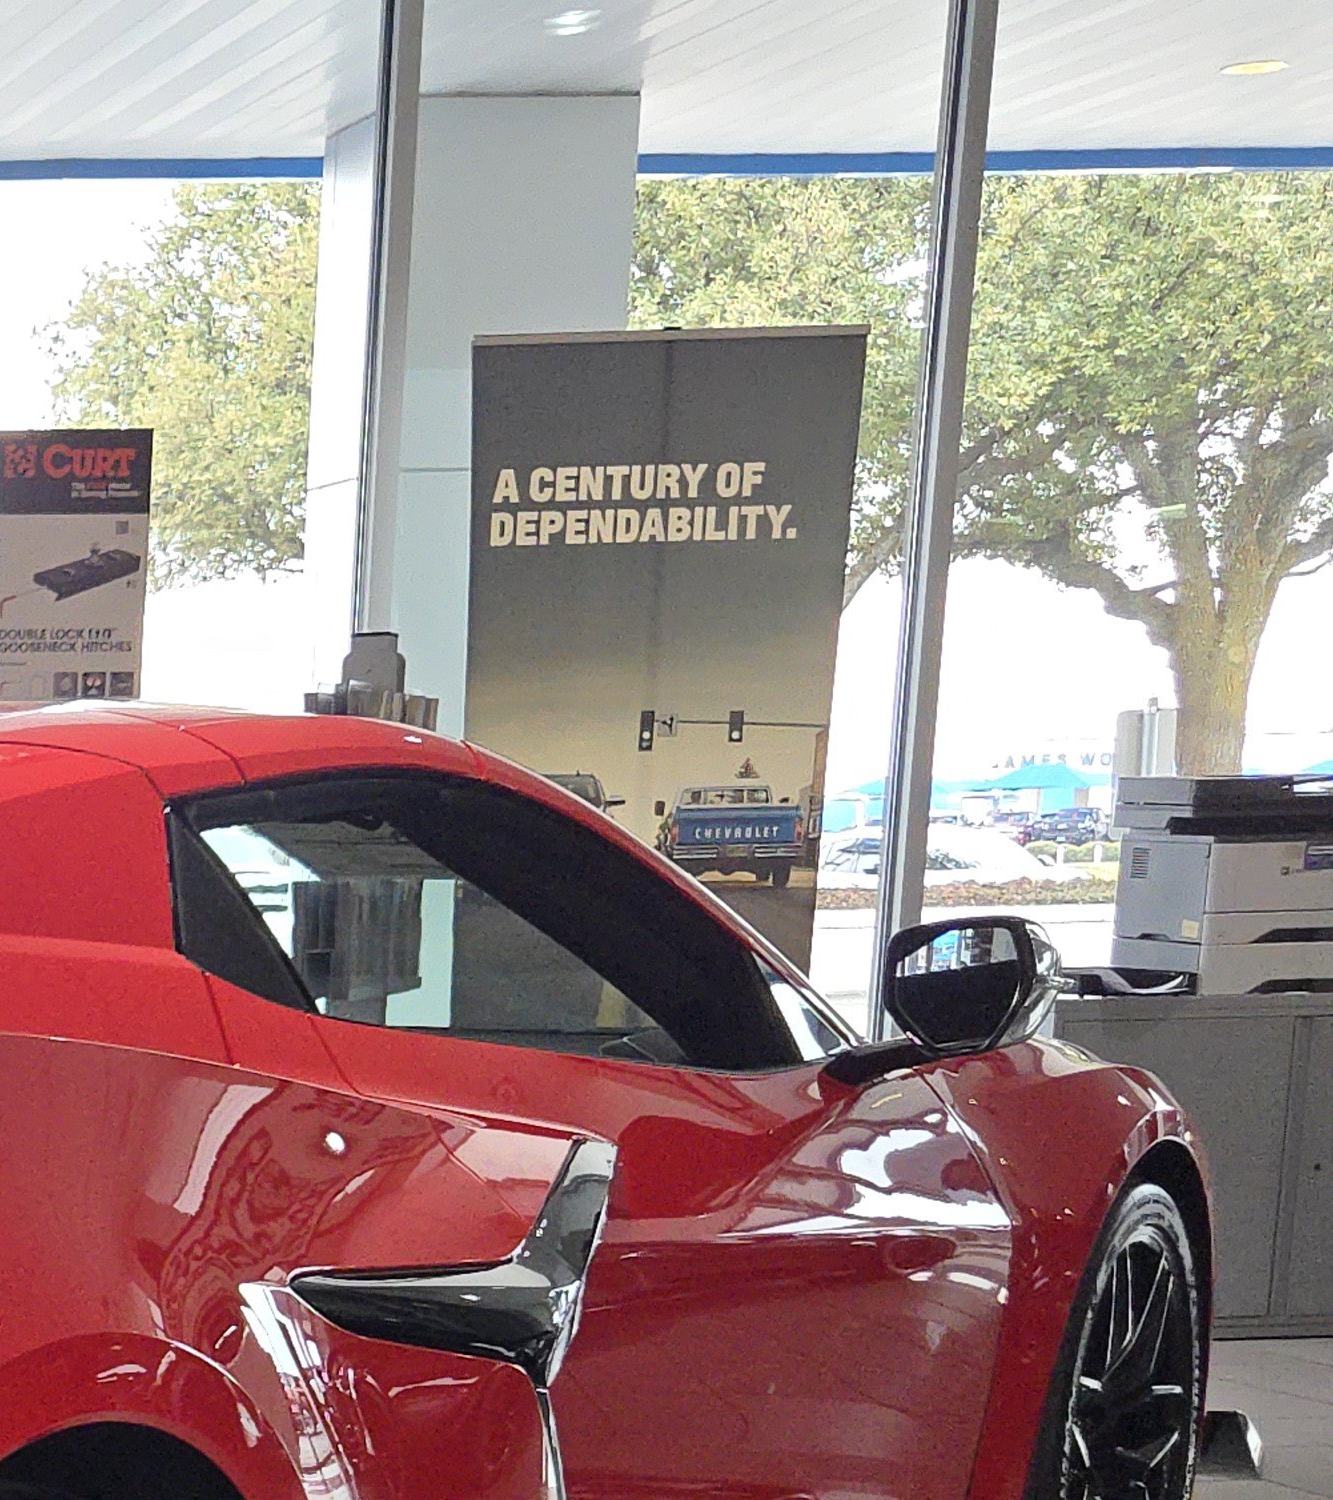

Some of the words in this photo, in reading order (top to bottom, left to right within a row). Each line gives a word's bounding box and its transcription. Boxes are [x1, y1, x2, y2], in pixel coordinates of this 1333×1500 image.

[43, 442, 136, 478] CURT
[492, 468, 520, 503] A
[529, 463, 708, 503] CENTURY
[716, 462, 766, 498] OF
[489, 505, 798, 547] DEPENDABILITY.
[49, 628, 84, 641] LOCK
[80, 640, 132, 653] HITCHES
[695, 825, 780, 839] CHEVROLET
